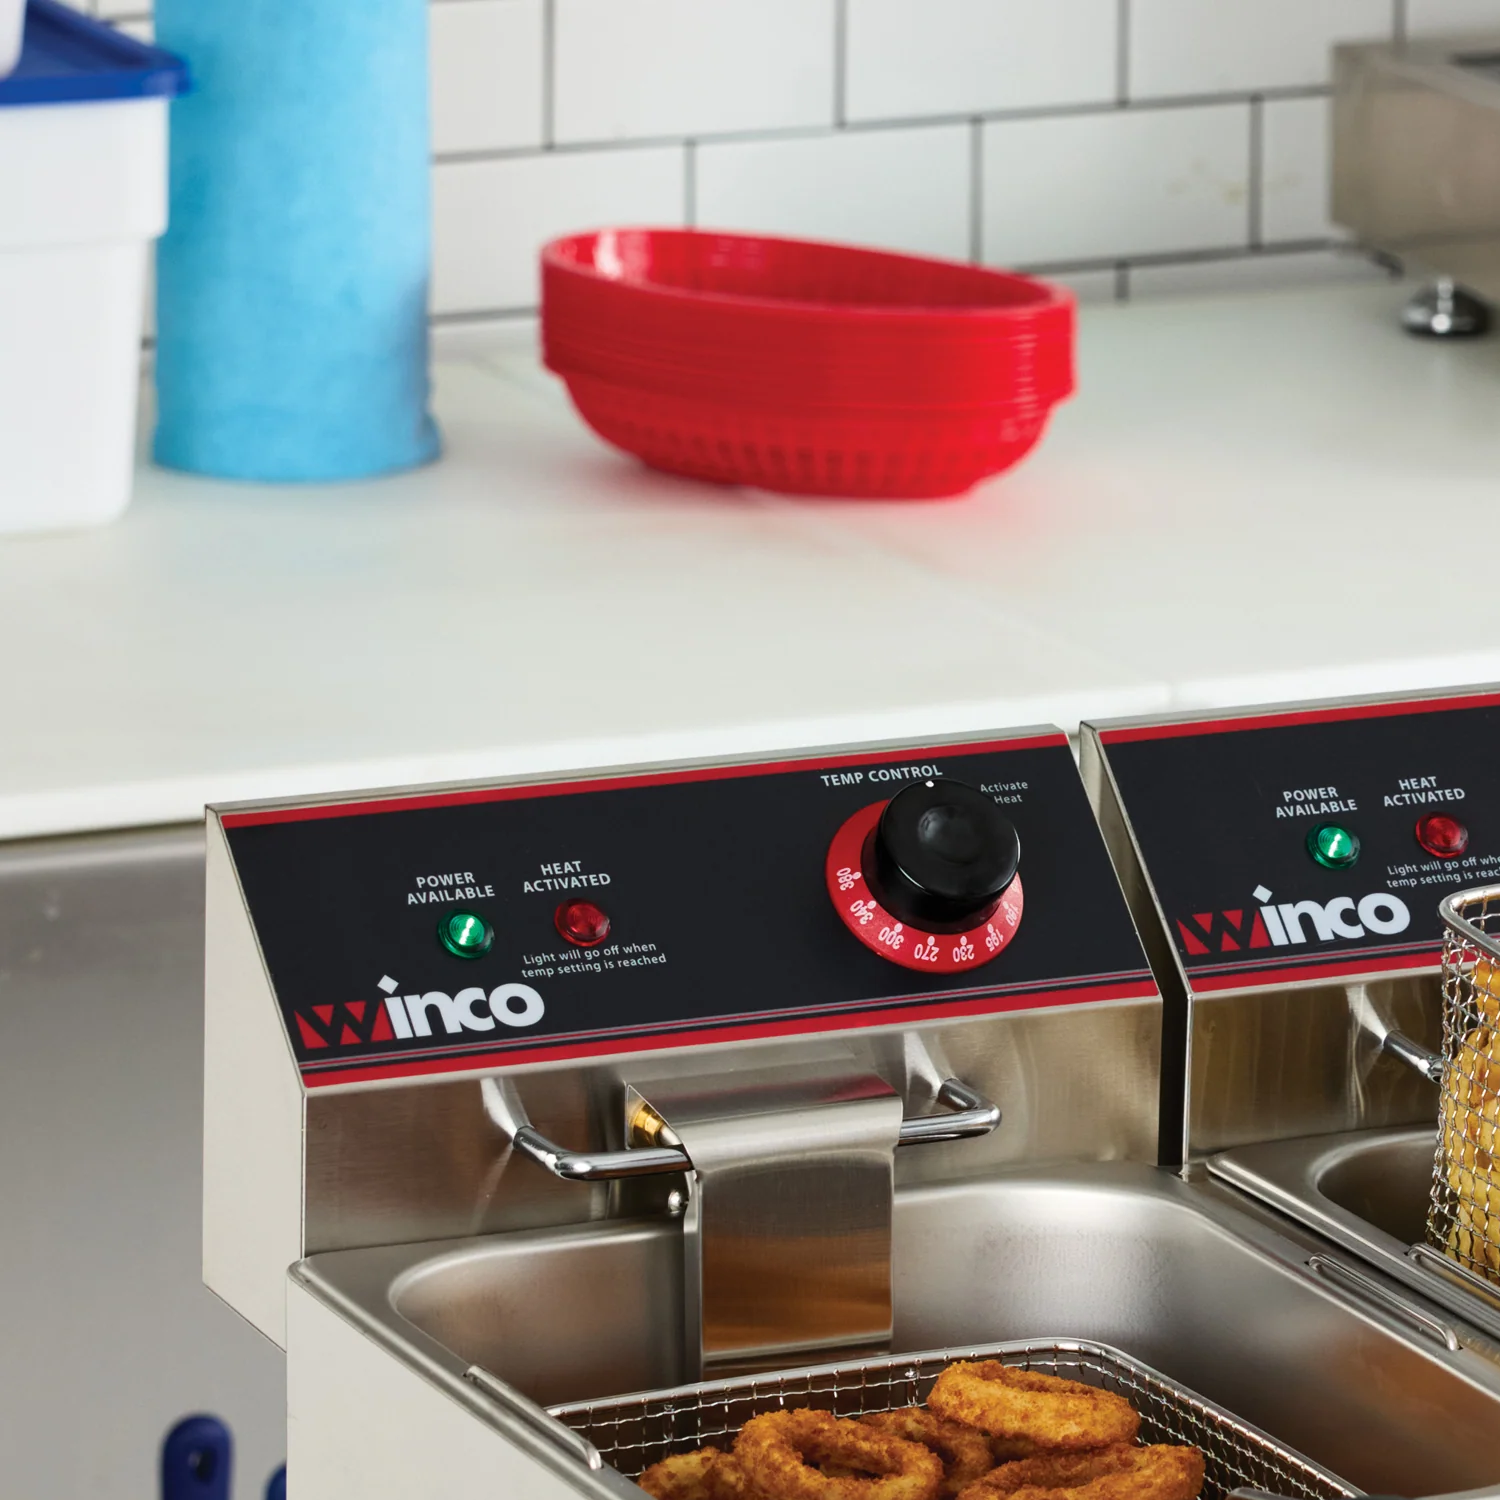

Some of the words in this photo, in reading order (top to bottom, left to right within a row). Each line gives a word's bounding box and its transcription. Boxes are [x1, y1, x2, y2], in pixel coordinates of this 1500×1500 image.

[821, 772, 864, 787] TEMP
[868, 765, 943, 783] CONTROL
[1398, 776, 1437, 791] HEAT
[980, 781, 1028, 793] Activate
[1283, 786, 1339, 802] POWER
[994, 794, 1023, 804] Heat
[1383, 788, 1466, 808] ACTIVATED
[1275, 799, 1358, 819] AVAILABLE
[540, 861, 582, 876] HEAT
[1387, 864, 1419, 878] Light
[1421, 860, 1441, 872] will
[1444, 860, 1460, 871] go
[1462, 856, 1478, 867] off
[416, 872, 475, 888] POWER
[523, 873, 611, 894] ACTIVATED
[836, 867, 854, 891] 380
[1386, 876, 1417, 889] temp
[1420, 870, 1462, 885] setting
[1463, 870, 1474, 880] is
[407, 885, 495, 905] AVAILABLE
[850, 900, 874, 925] 340
[878, 926, 904, 950] 300
[985, 929, 1004, 952] 195
[523, 953, 556, 966] Light
[558, 949, 581, 961] will
[584, 949, 600, 961] go
[602, 946, 619, 956] off
[622, 942, 657, 954] when
[914, 943, 940, 962] 270
[952, 944, 975, 962] 230
[522, 966, 555, 978] temp
[557, 961, 601, 975] setting
[604, 960, 615, 970] is
[617, 954, 667, 968] reached
